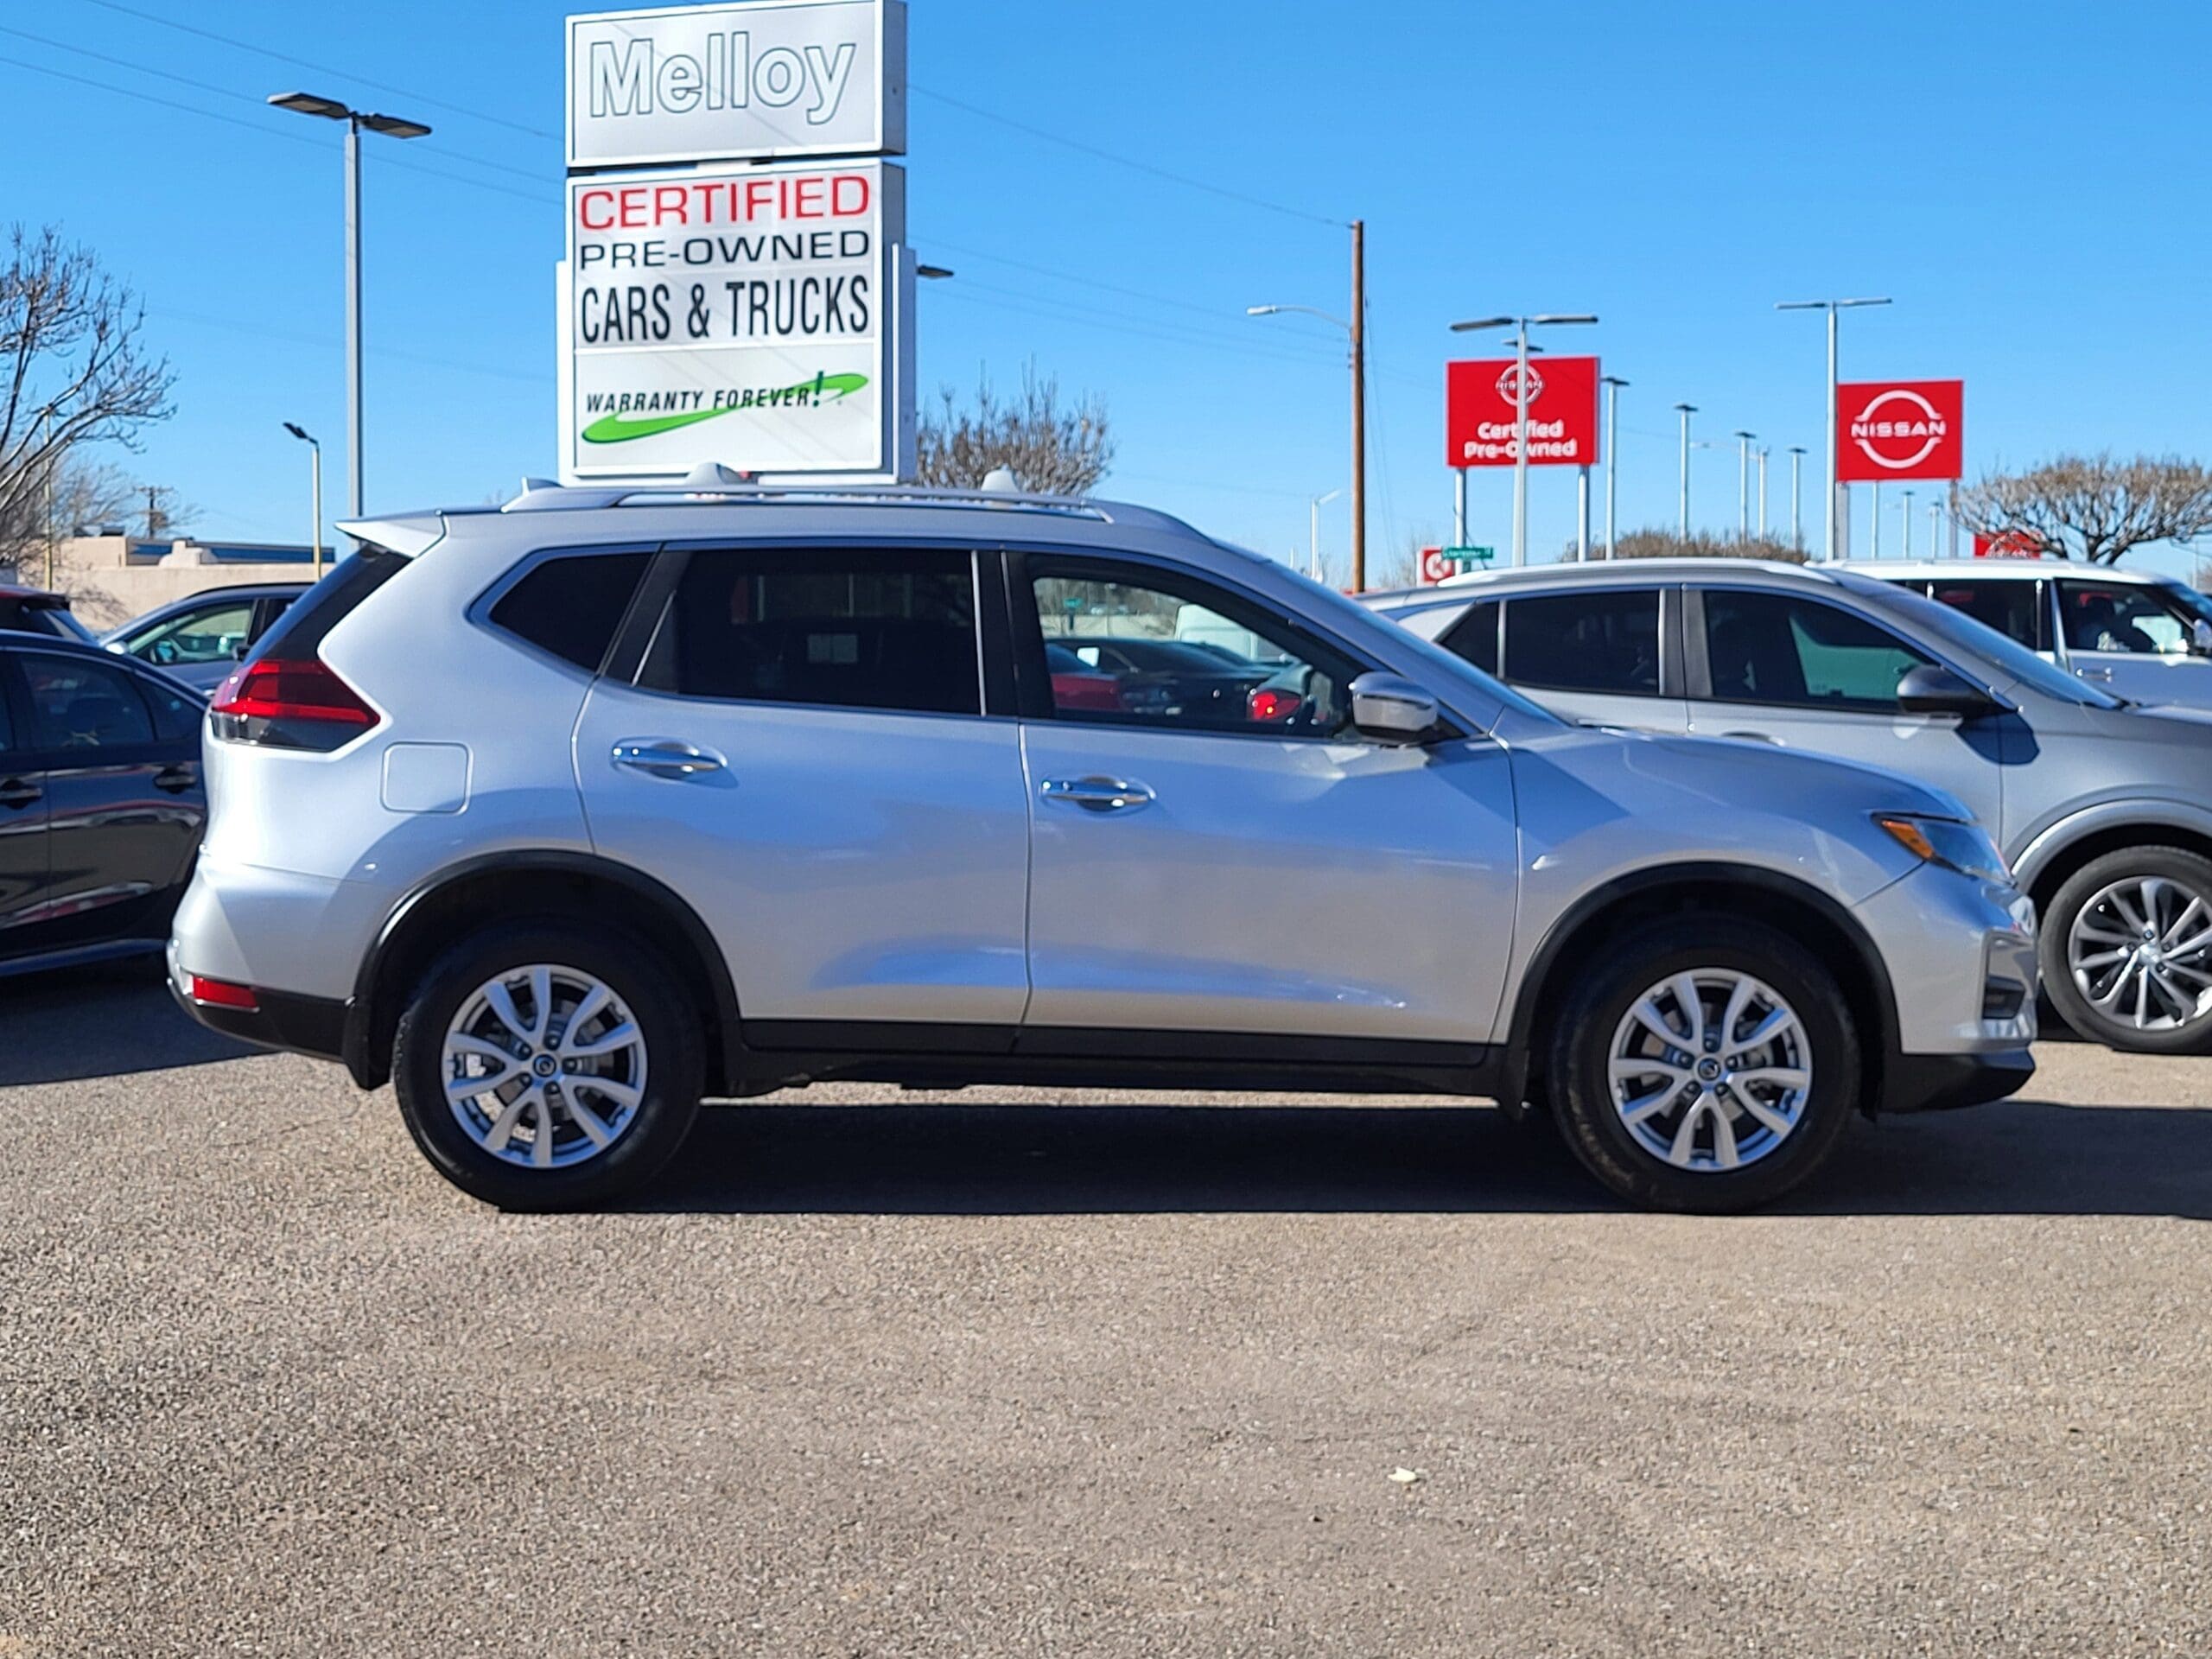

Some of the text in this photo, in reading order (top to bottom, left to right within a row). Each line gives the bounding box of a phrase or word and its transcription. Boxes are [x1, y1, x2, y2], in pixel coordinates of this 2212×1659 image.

[590, 31, 856, 125] Melloy
[581, 175, 869, 230] CERTIFIED
[581, 231, 869, 270] PRE-OWNED
[582, 275, 869, 343] CARS & TRUCKS
[587, 371, 824, 413] WARRANTY FOREVER!
[1478, 419, 1563, 440] Certfied
[1851, 421, 1946, 437] NISSAN
